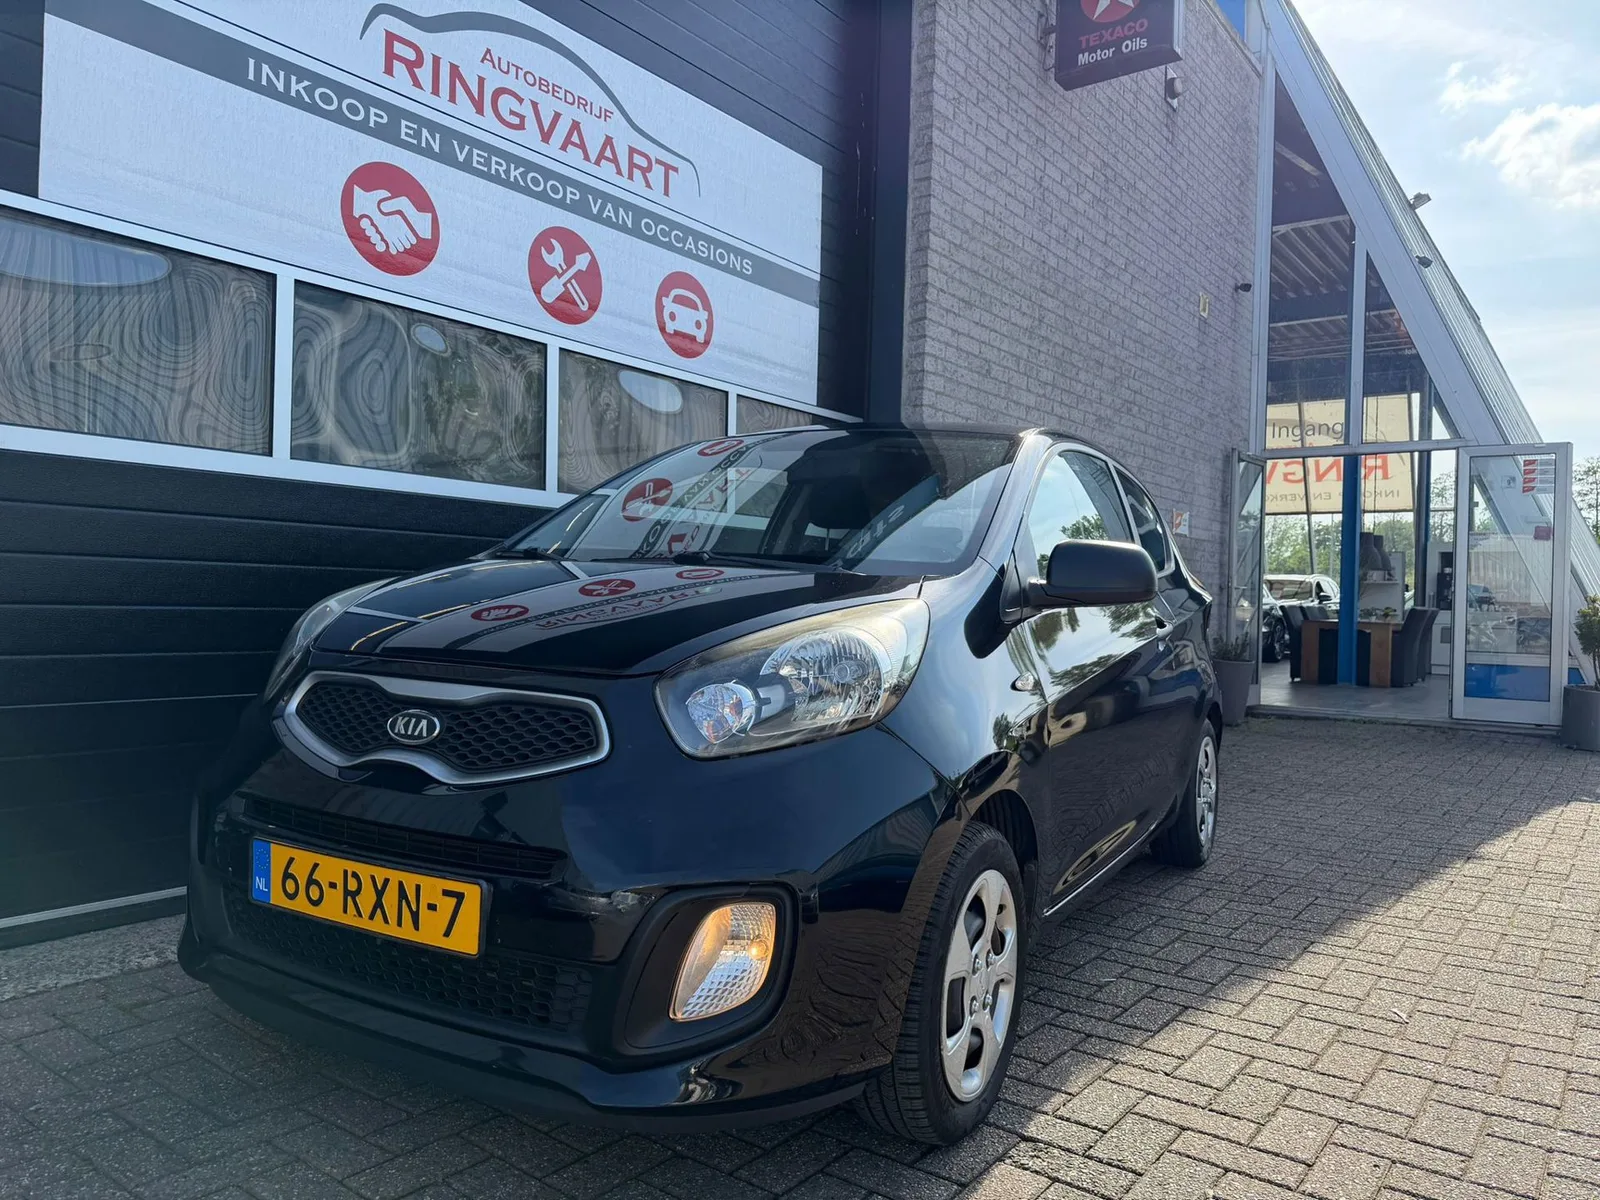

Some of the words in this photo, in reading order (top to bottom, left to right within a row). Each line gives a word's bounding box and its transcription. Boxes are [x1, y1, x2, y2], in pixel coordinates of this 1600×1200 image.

[1079, 19, 1149, 49] TEXACO
[1078, 47, 1115, 66] Motor
[1121, 37, 1148, 53] Oils
[480, 47, 614, 124] AUTOBEDRIJF
[382, 29, 679, 198] RINGVAART
[247, 58, 389, 131] INKOOP
[400, 119, 441, 154] EN
[452, 144, 580, 203] VERKOOP
[588, 193, 633, 228] VAN
[641, 218, 753, 275] OCCASIONS
[1272, 421, 1344, 443] Ingang
[395, 717, 428, 738] KIA
[256, 876, 268, 892] NL
[281, 856, 466, 938] 66-RXN-7
